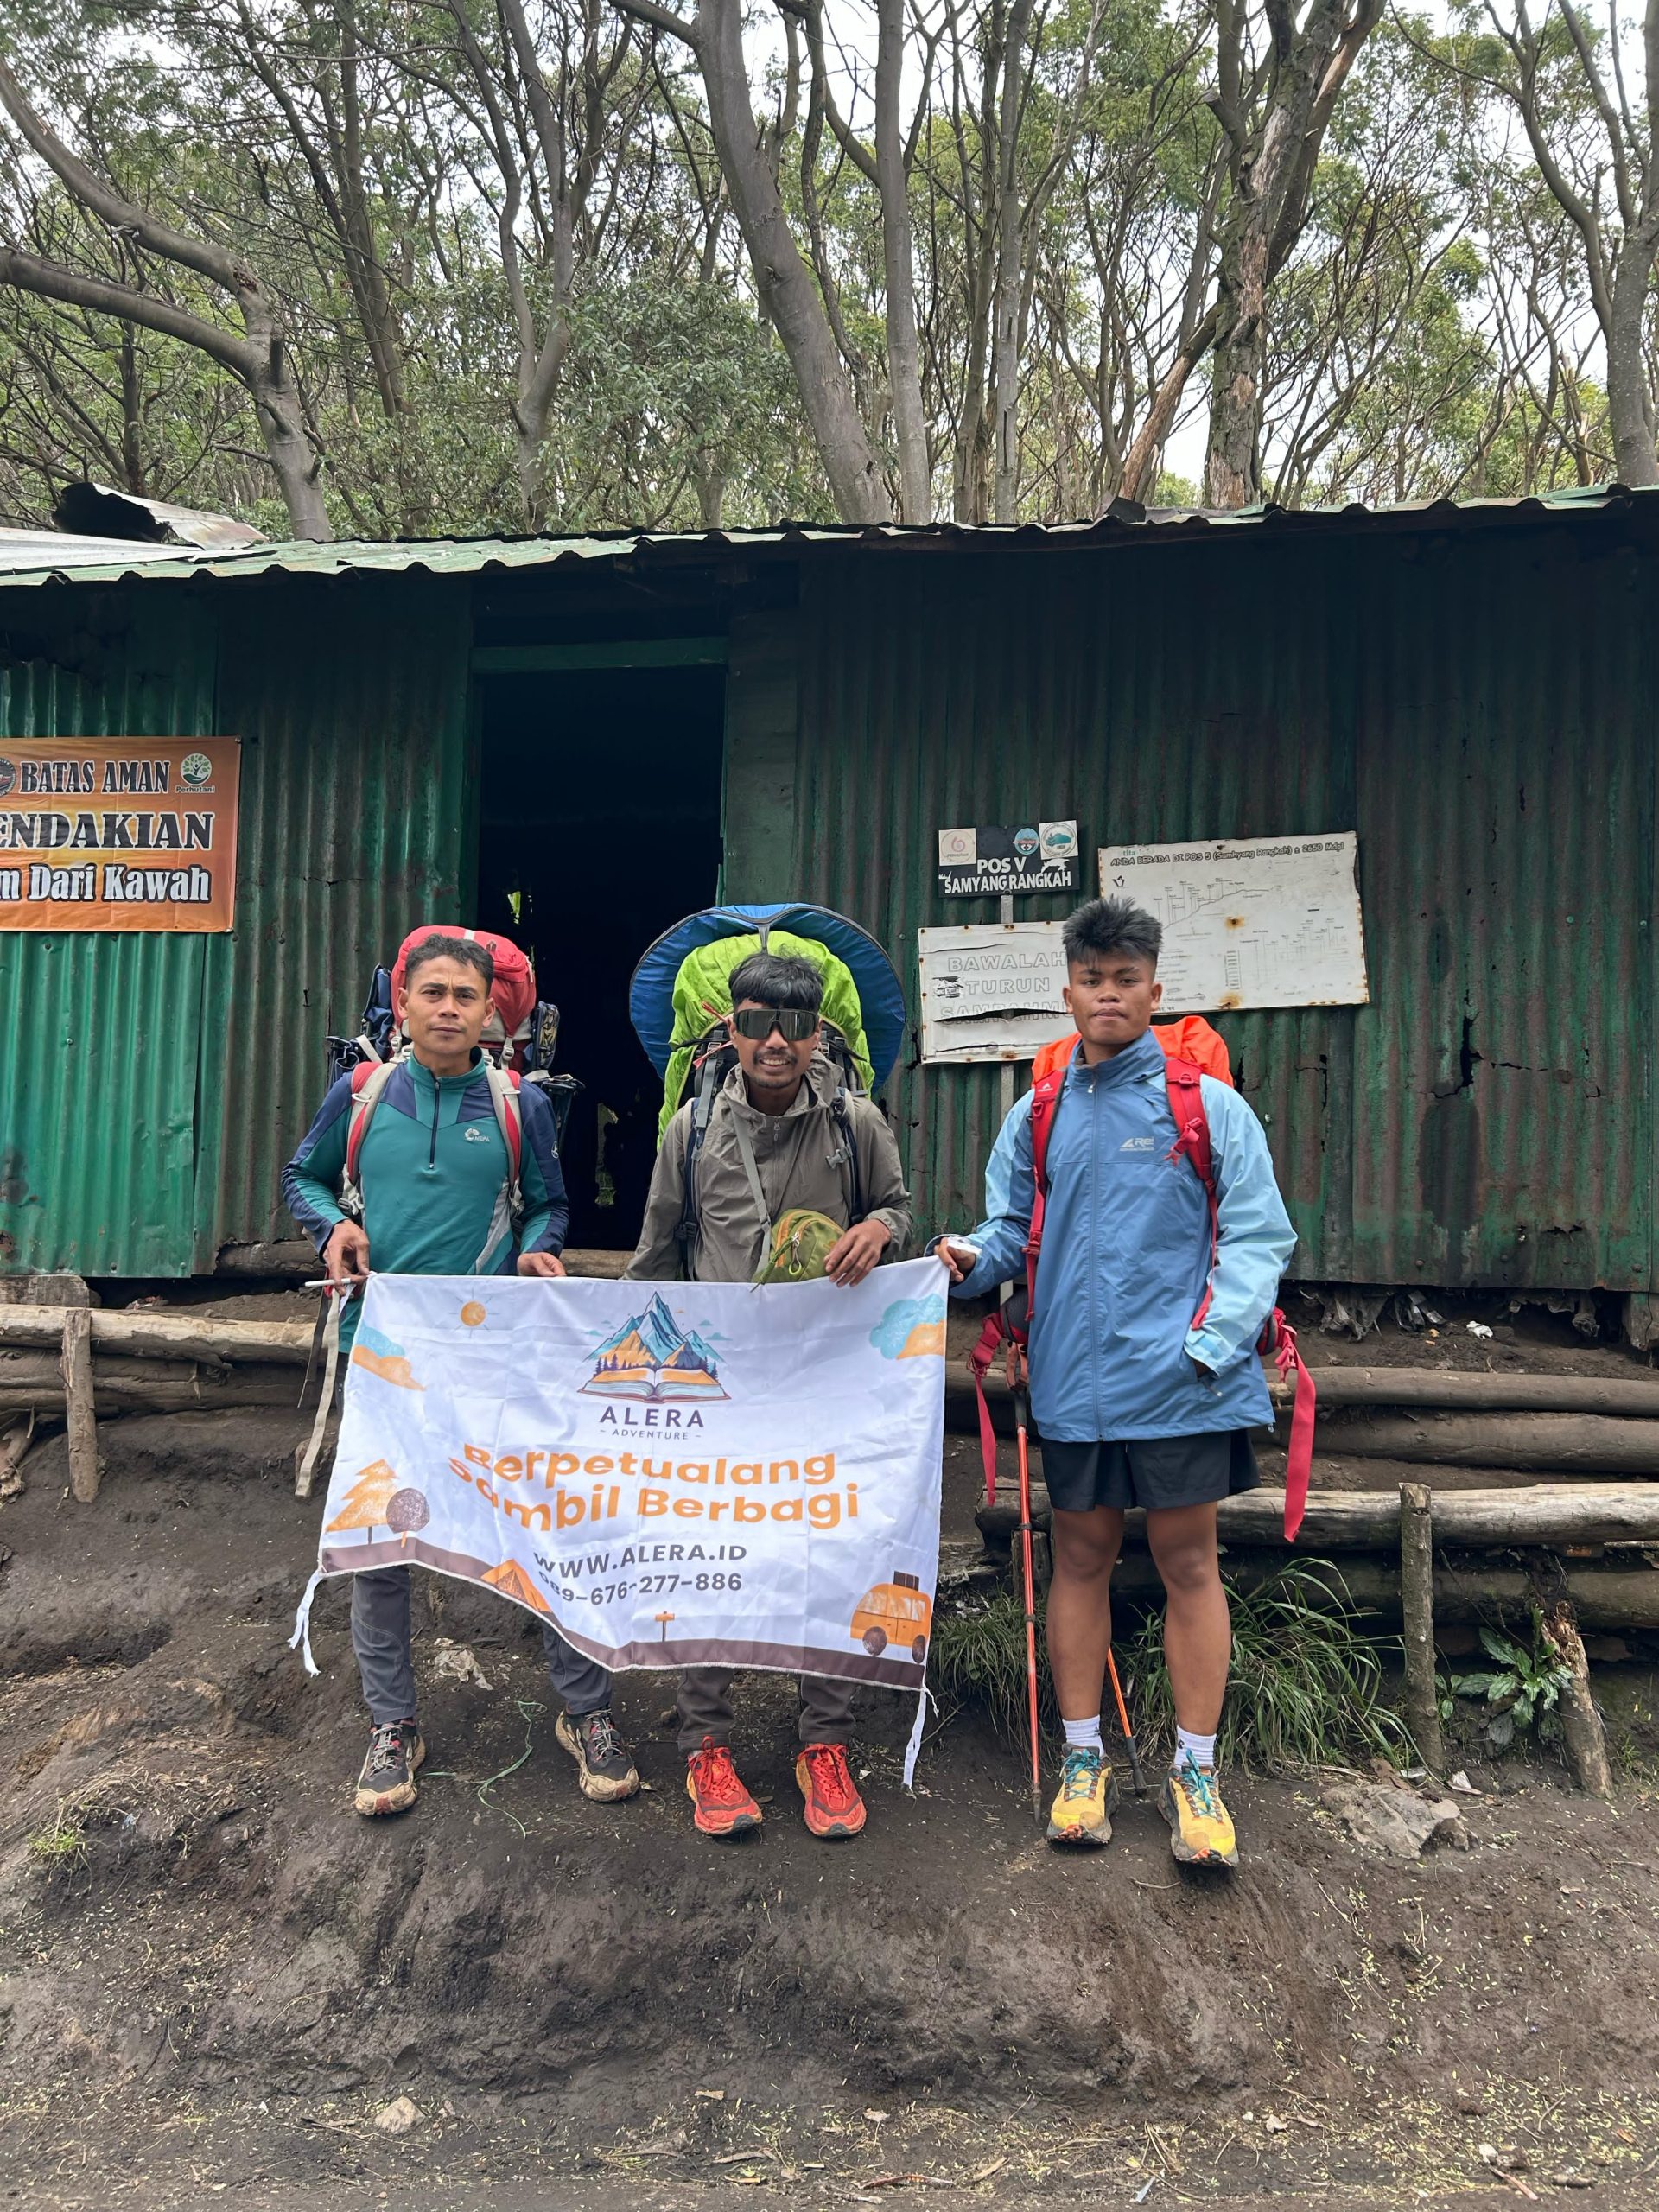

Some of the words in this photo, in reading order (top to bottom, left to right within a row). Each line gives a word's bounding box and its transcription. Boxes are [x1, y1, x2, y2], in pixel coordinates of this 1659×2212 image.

[20, 760, 95, 794] BATAS
[101, 760, 171, 794] AMAN
[175, 785, 216, 794] Perhutani
[977, 857, 1011, 874] POS
[1014, 856, 1027, 873] V
[1110, 857, 1135, 867] ANDA
[1137, 854, 1170, 865] BERADA
[1173, 852, 1184, 862] DI
[1185, 851, 1204, 861] POS
[1205, 851, 1211, 861] 5
[1256, 846, 1293, 857] Rangkah)
[1302, 843, 1324, 853] 2650
[29, 863, 95, 902] Dari
[102, 865, 211, 903] Kawah
[944, 874, 1007, 894] SAMYANG
[1009, 871, 1071, 890] RANGKAH
[948, 951, 1067, 973] BAWALAH
[965, 977, 1051, 995] TURUN
[599, 1405, 704, 1428] ALERA
[612, 1428, 690, 1440] ADVENTURE
[463, 1443, 836, 1489] Berpetualang
[448, 1457, 620, 1532] Sambil
[637, 1482, 859, 1530] Berbagi
[533, 1544, 747, 1579] WWW.ALERA.ID
[538, 1571, 743, 1606] 089-676-277-886
